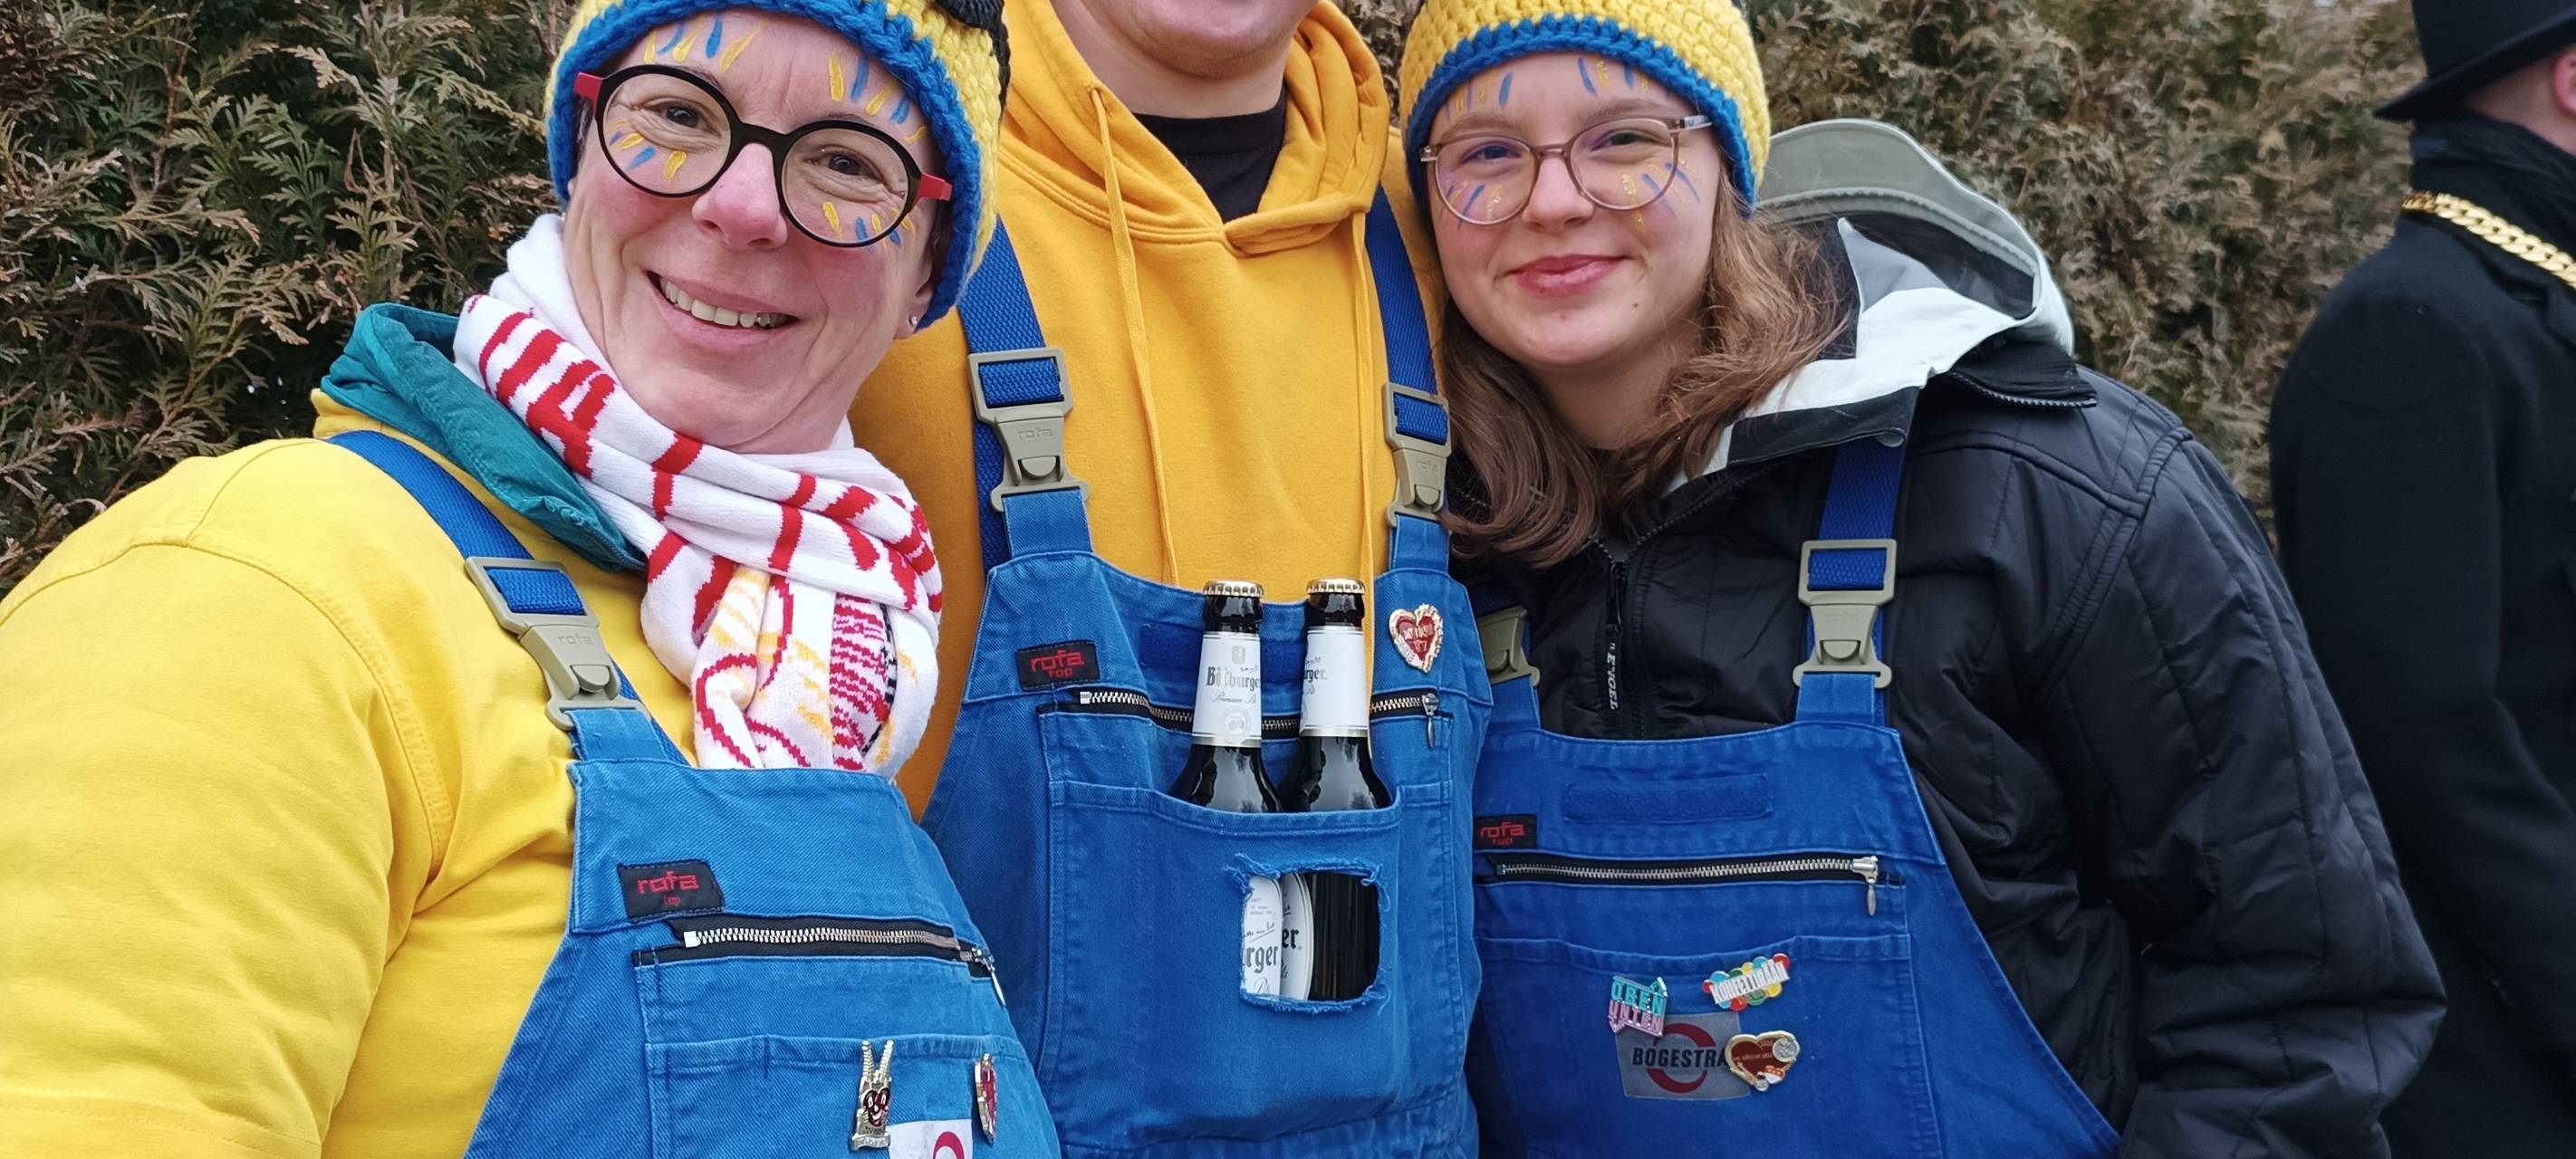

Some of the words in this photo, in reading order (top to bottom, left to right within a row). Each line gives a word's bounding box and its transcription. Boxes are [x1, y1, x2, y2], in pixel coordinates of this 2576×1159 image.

[1030, 649, 1084, 673] rofa
[1480, 821, 1524, 838] rofa
[638, 870, 699, 894] rofa
